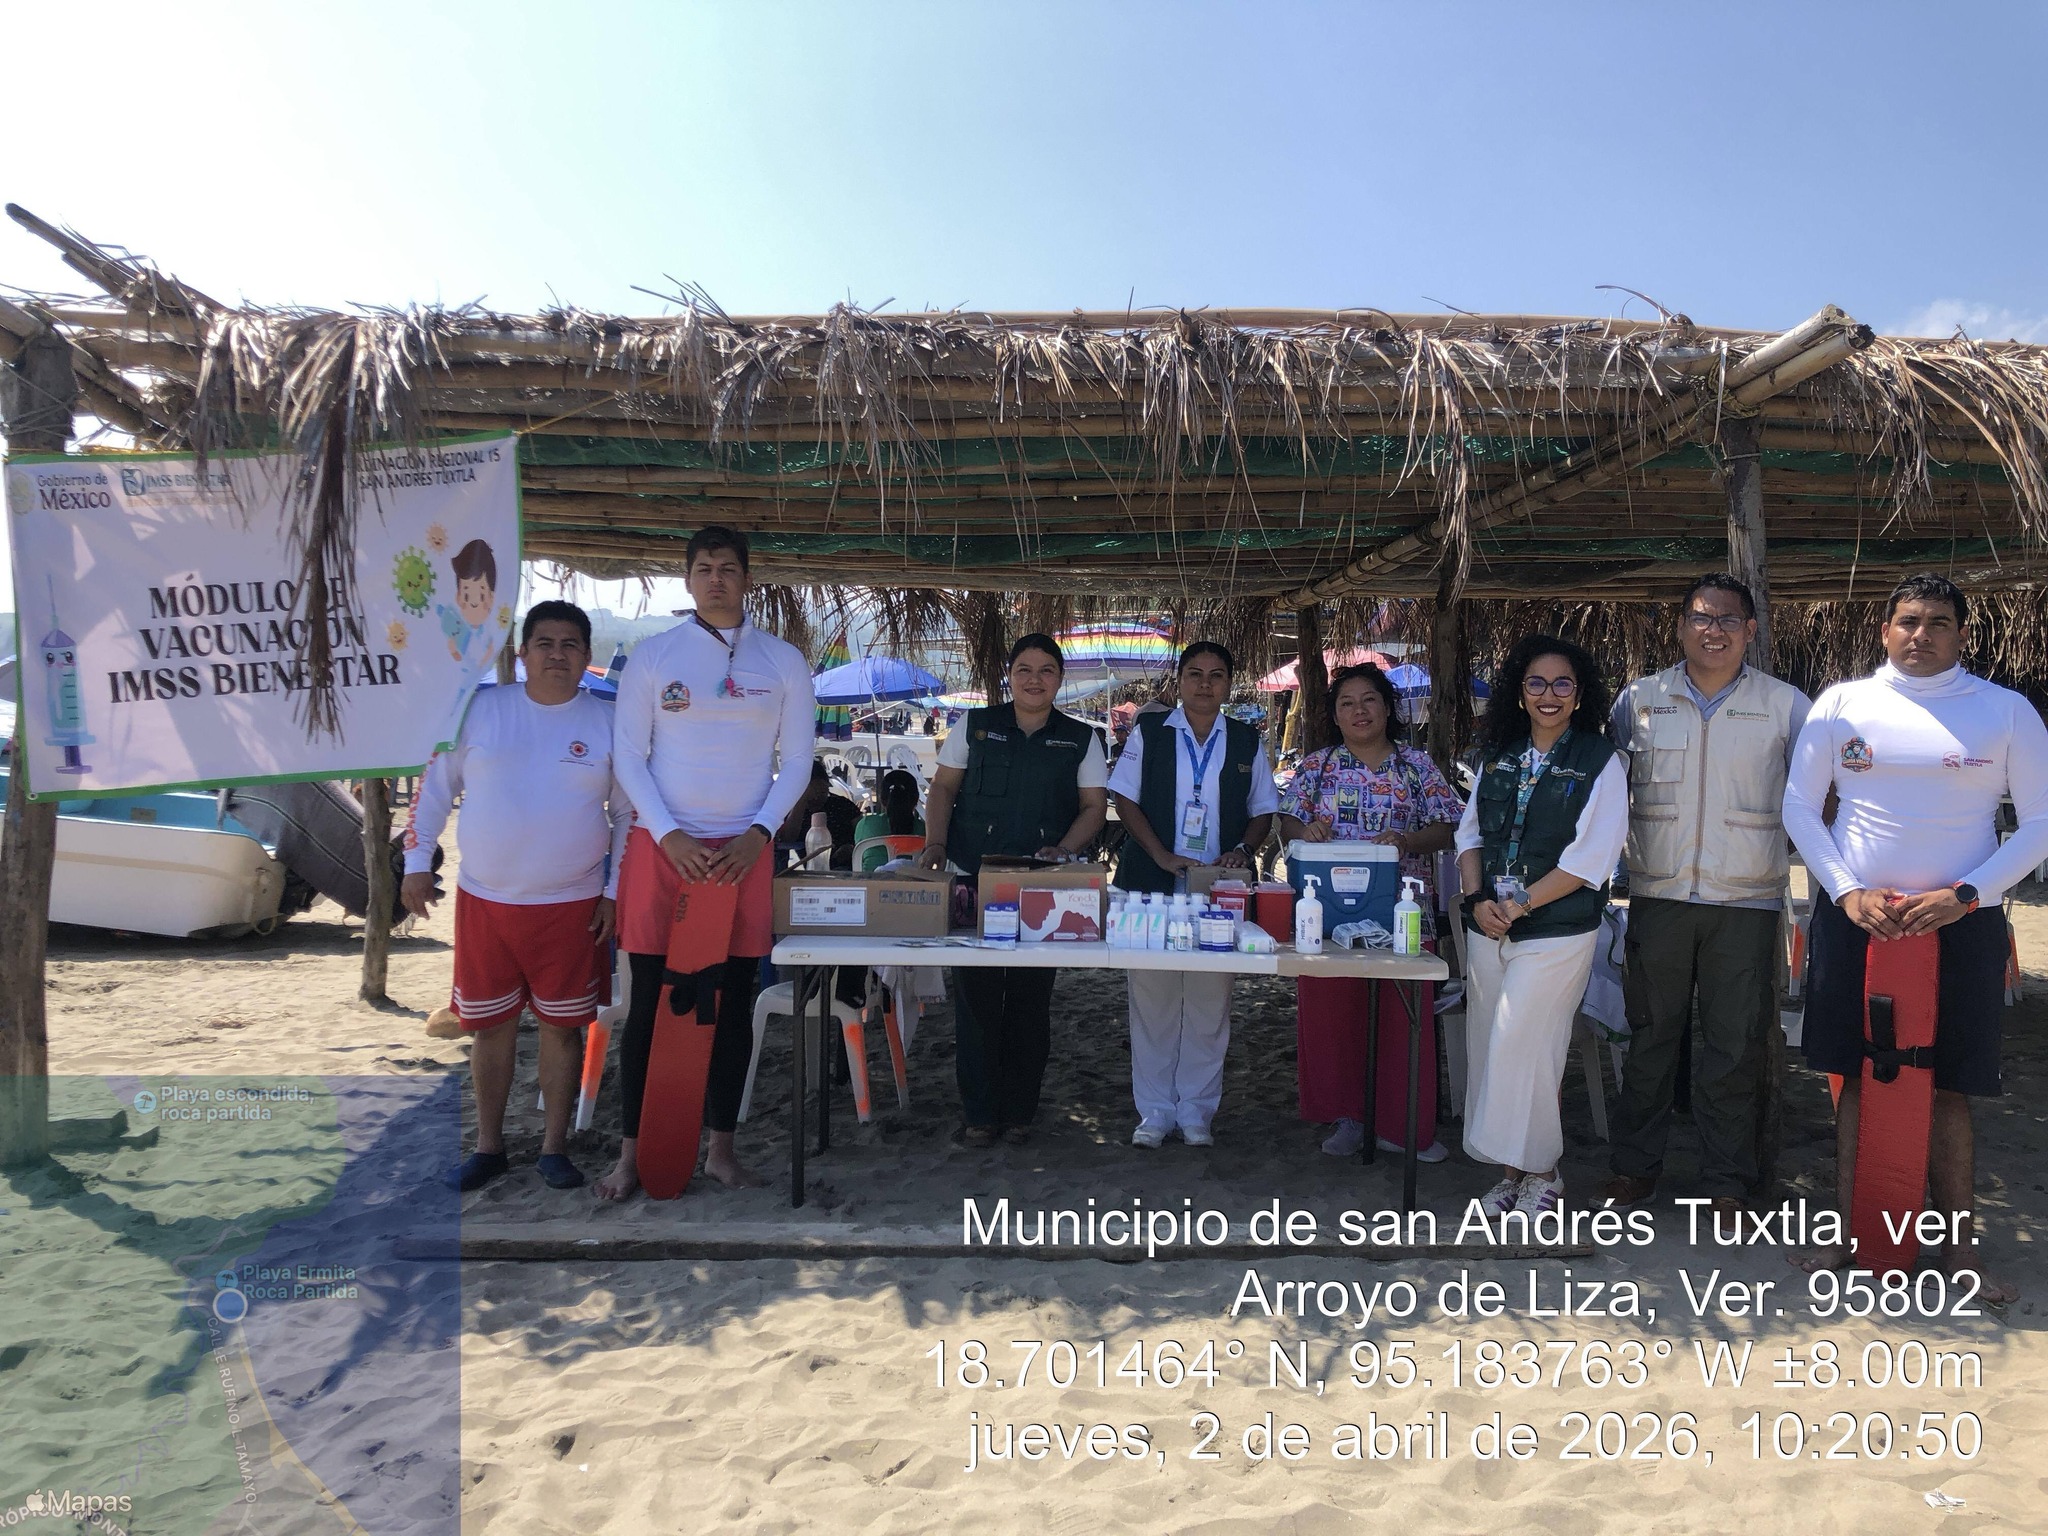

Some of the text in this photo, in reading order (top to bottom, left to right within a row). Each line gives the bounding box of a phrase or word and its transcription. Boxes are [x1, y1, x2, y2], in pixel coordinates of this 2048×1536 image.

[37, 472, 108, 488] Gobierno de
[435, 468, 477, 486] TUXTLA
[39, 488, 112, 511] México
[148, 573, 297, 619] MÓDULO
[140, 605, 367, 660] VACUNACÓN
[107, 665, 202, 704] IMSS
